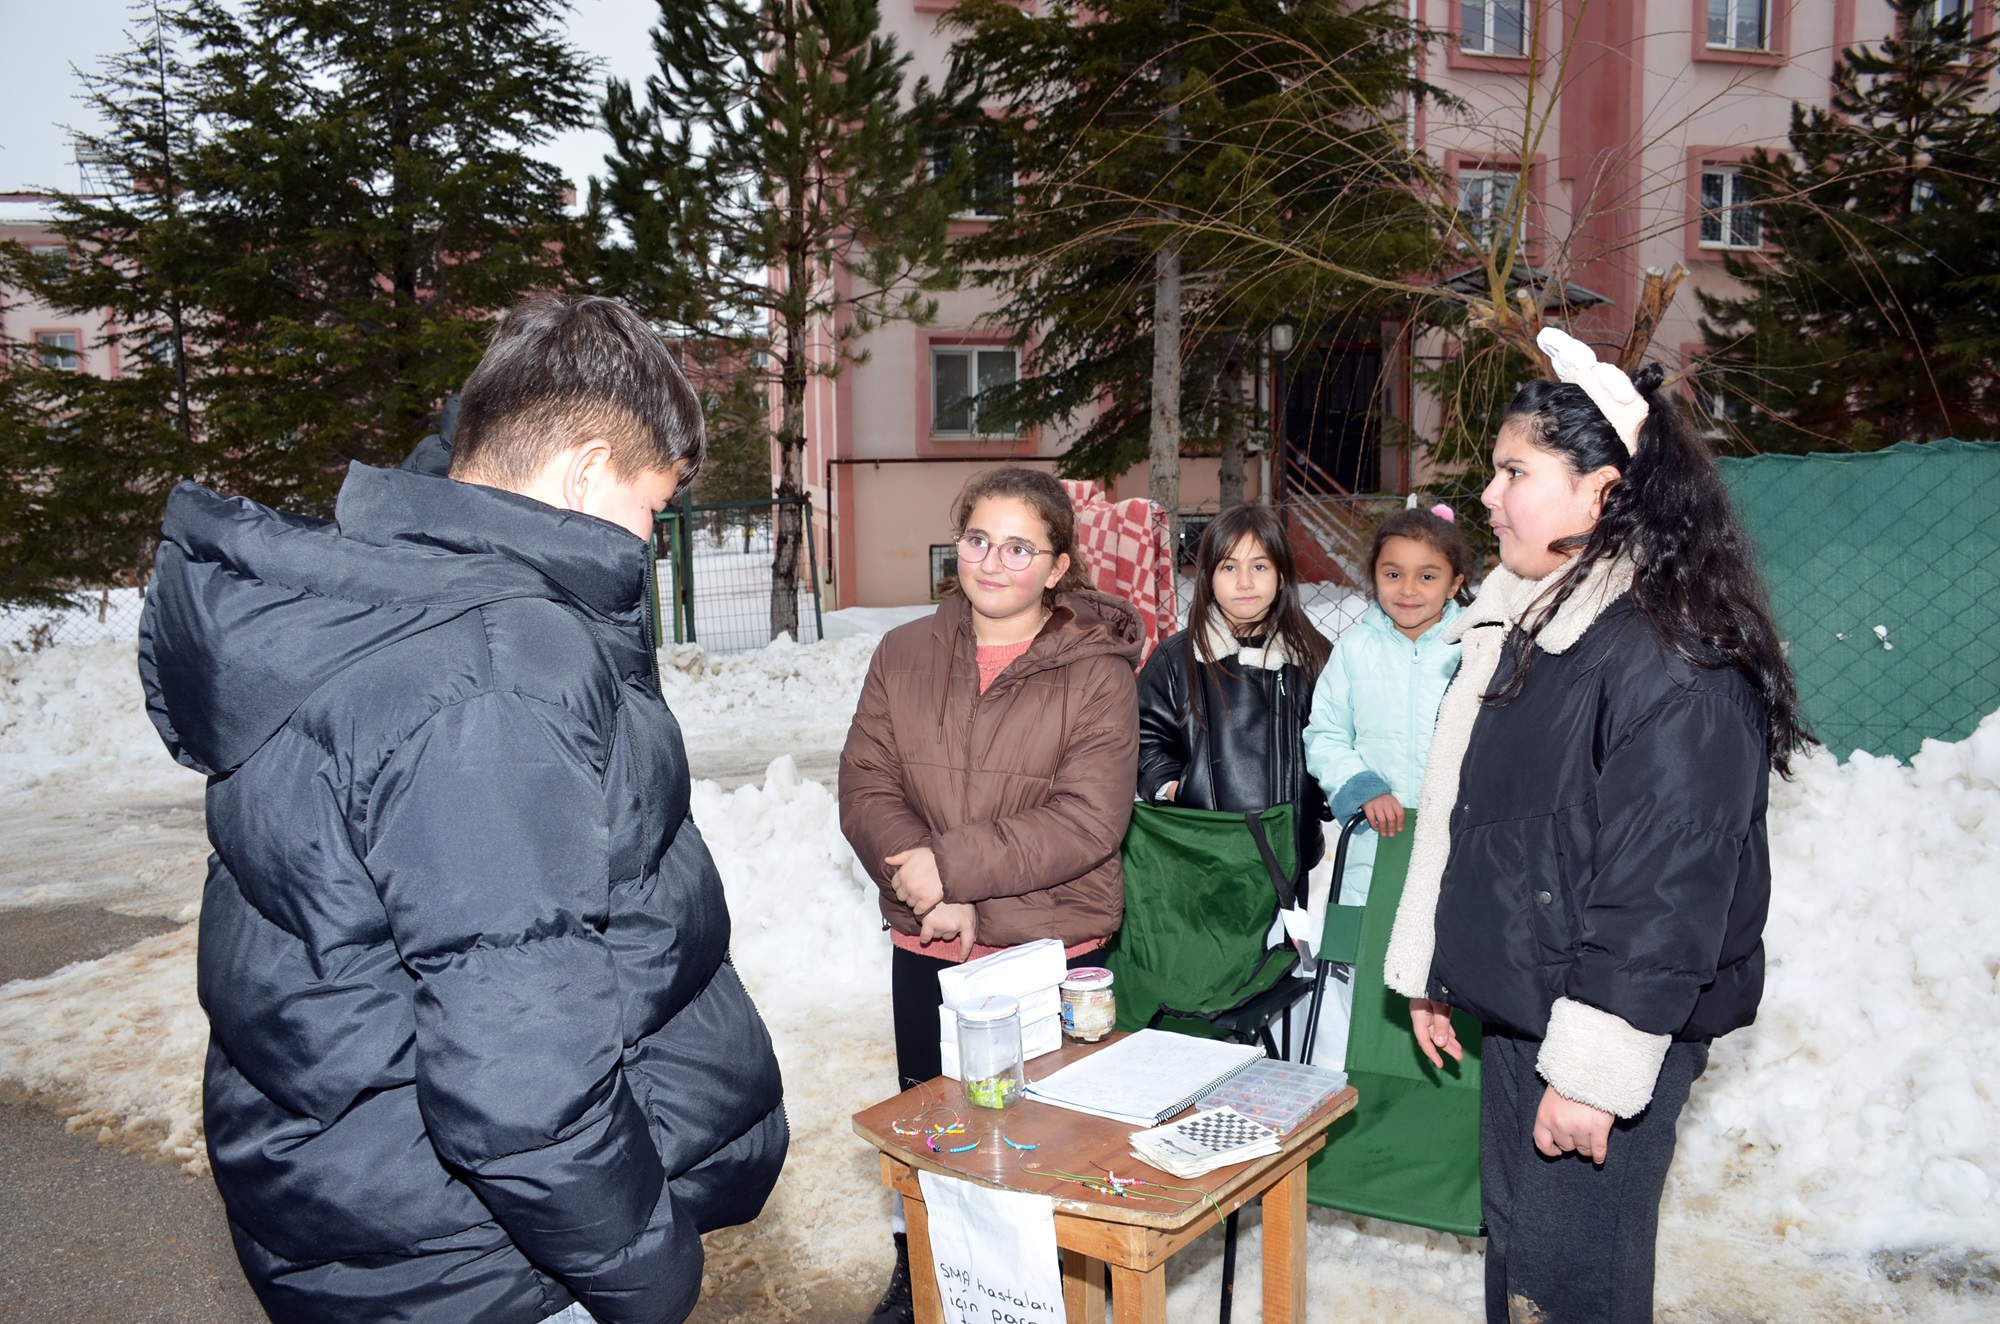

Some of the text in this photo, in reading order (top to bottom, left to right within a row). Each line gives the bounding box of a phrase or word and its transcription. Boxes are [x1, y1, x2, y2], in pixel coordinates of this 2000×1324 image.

[940, 1262, 970, 1286] SMA
[949, 1287, 979, 1313] için
[991, 1309, 1040, 1324] par
